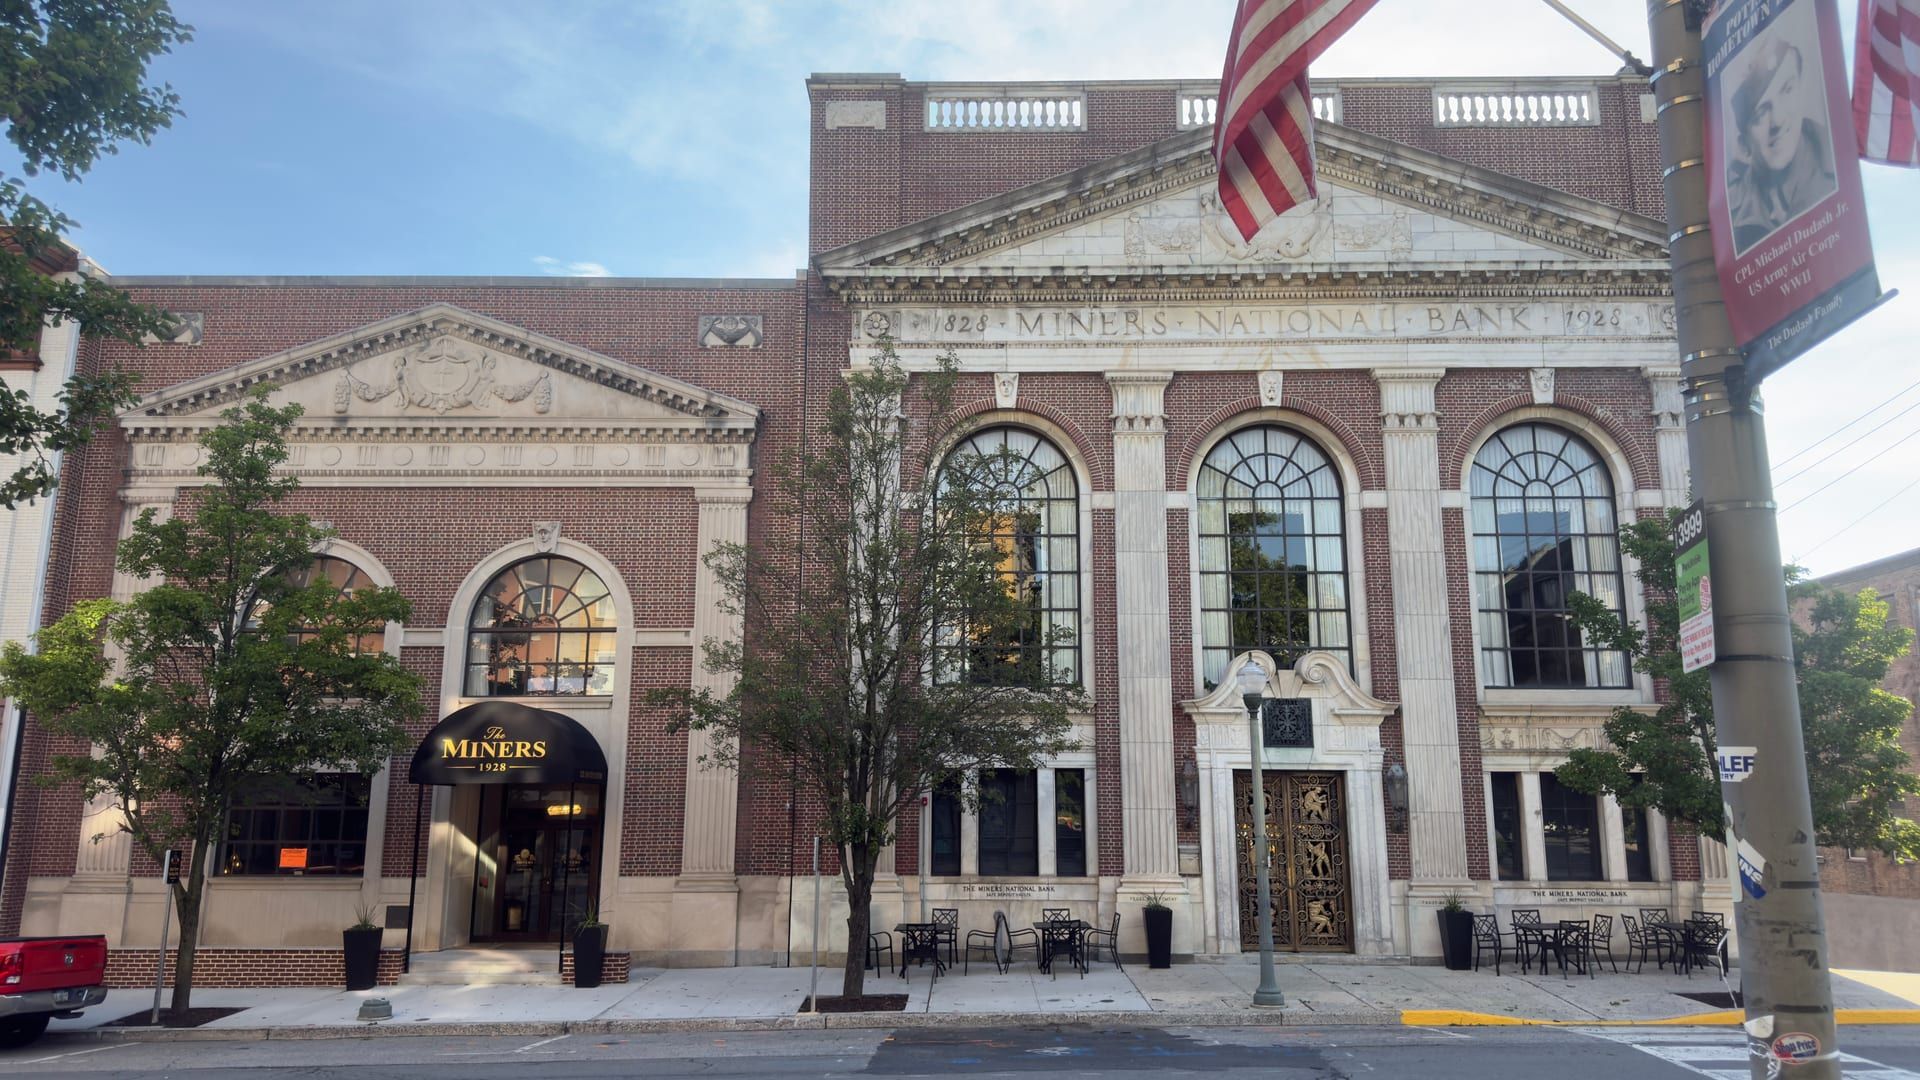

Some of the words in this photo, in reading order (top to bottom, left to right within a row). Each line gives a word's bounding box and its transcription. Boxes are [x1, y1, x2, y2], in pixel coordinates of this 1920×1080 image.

[1707, 1, 1771, 79] HOMETOWN
[1735, 263, 1755, 284] CPL
[1755, 237, 1792, 270] Michael
[1793, 211, 1833, 244] Dudash
[1836, 202, 1849, 218] Jr.
[1748, 279, 1762, 297] US
[1763, 263, 1789, 289] Army
[1791, 252, 1807, 270] Air
[1808, 231, 1841, 257] Corps
[1779, 268, 1812, 297] WWII
[933, 312, 989, 333] 1828
[1016, 309, 1168, 336] MINERS
[1195, 308, 1399, 335] NATIONAL
[1427, 307, 1532, 332] BANK
[1566, 308, 1622, 328] 1928
[1767, 334, 1782, 350] The
[1783, 314, 1812, 338] Dudash
[1814, 295, 1842, 320] Family
[1678, 509, 1702, 546] 3999
[483, 726, 506, 740] The
[479, 762, 507, 772] 1928
[1797, 1039, 1817, 1052] Price
